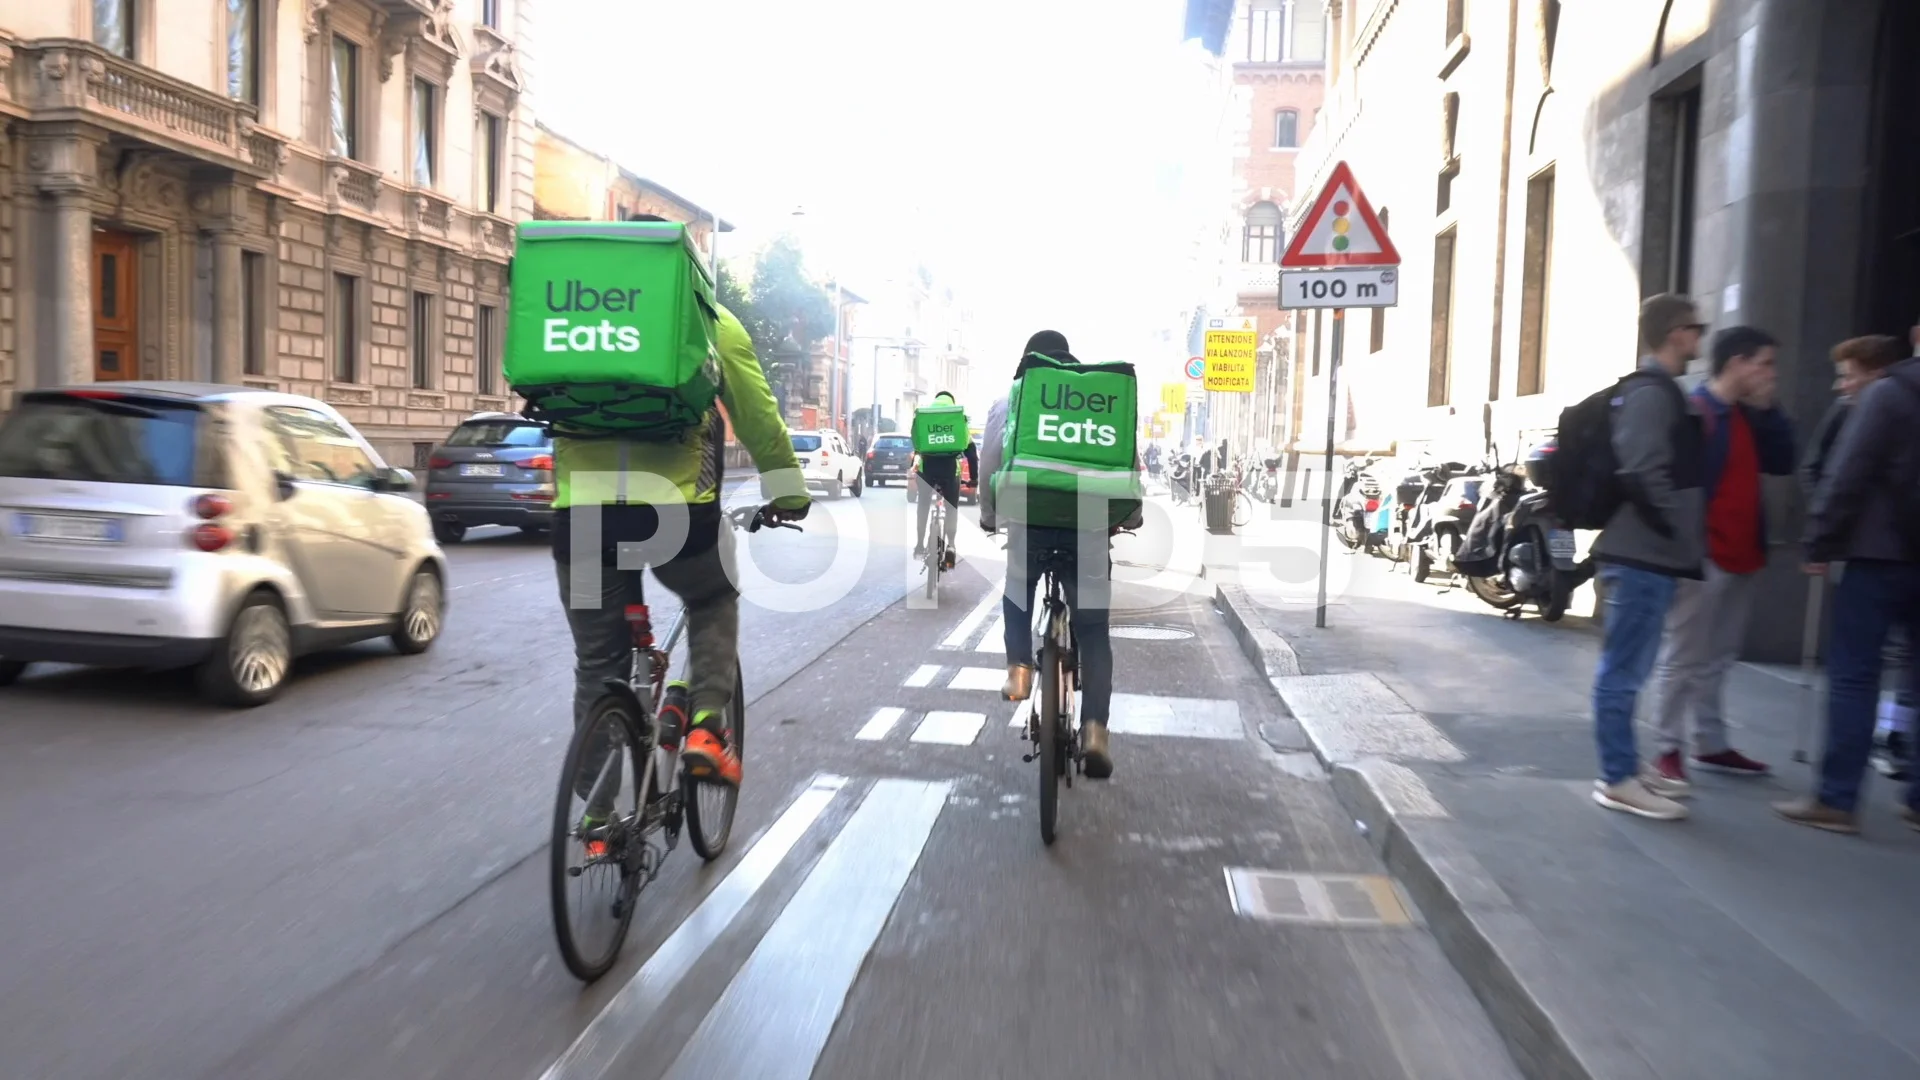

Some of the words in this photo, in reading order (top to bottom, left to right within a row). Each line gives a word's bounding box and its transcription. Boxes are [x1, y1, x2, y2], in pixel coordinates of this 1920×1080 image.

[546, 279, 641, 312] Uber
[1299, 279, 1346, 299] 100
[1356, 282, 1379, 298] m
[543, 318, 640, 352] Eats
[1208, 334, 1253, 344] ATTENZIONE
[1207, 348, 1218, 357] VIA
[1220, 348, 1253, 358] LANZONE
[1207, 377, 1250, 387] MODIFICATA
[1040, 383, 1118, 414] Uber
[927, 423, 954, 434] Uber
[1037, 414, 1116, 447] Eats
[928, 434, 955, 445] Eats
